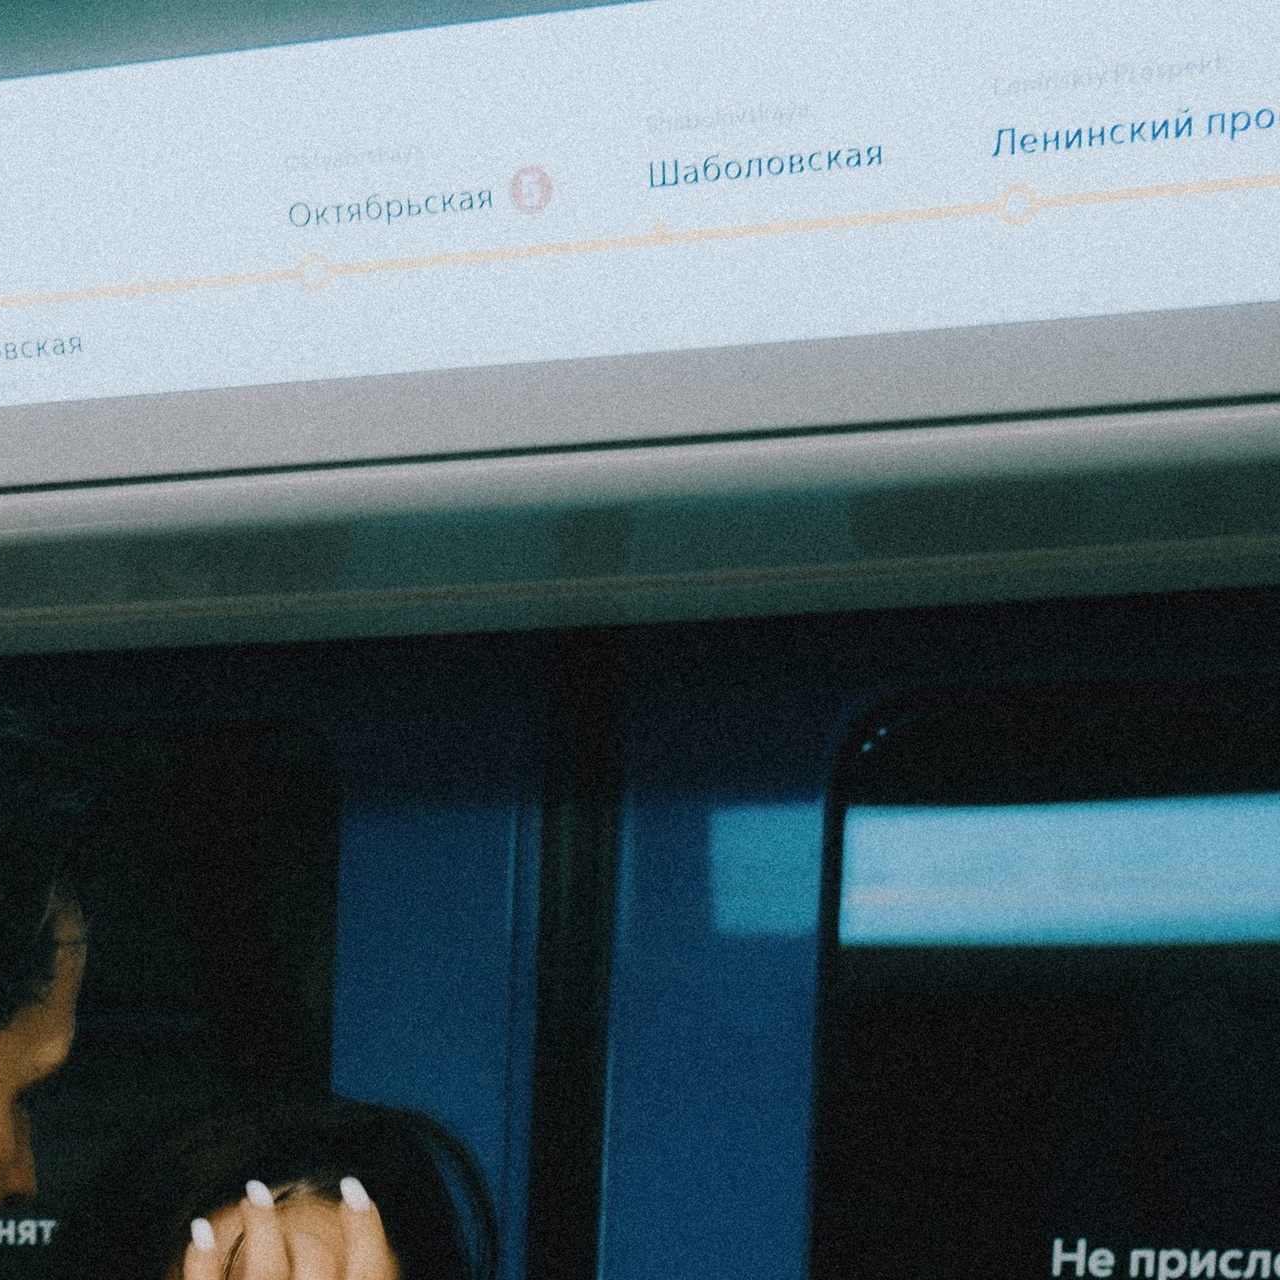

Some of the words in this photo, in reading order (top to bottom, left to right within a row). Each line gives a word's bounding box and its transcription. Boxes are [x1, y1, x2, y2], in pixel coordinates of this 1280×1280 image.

[991, 106, 1196, 159] Ленинский
[1205, 105, 1280, 143] про
[646, 143, 885, 190] Шаболовская
[287, 186, 495, 229] Октябрьская
[1051, 1237, 1116, 1280] Не
